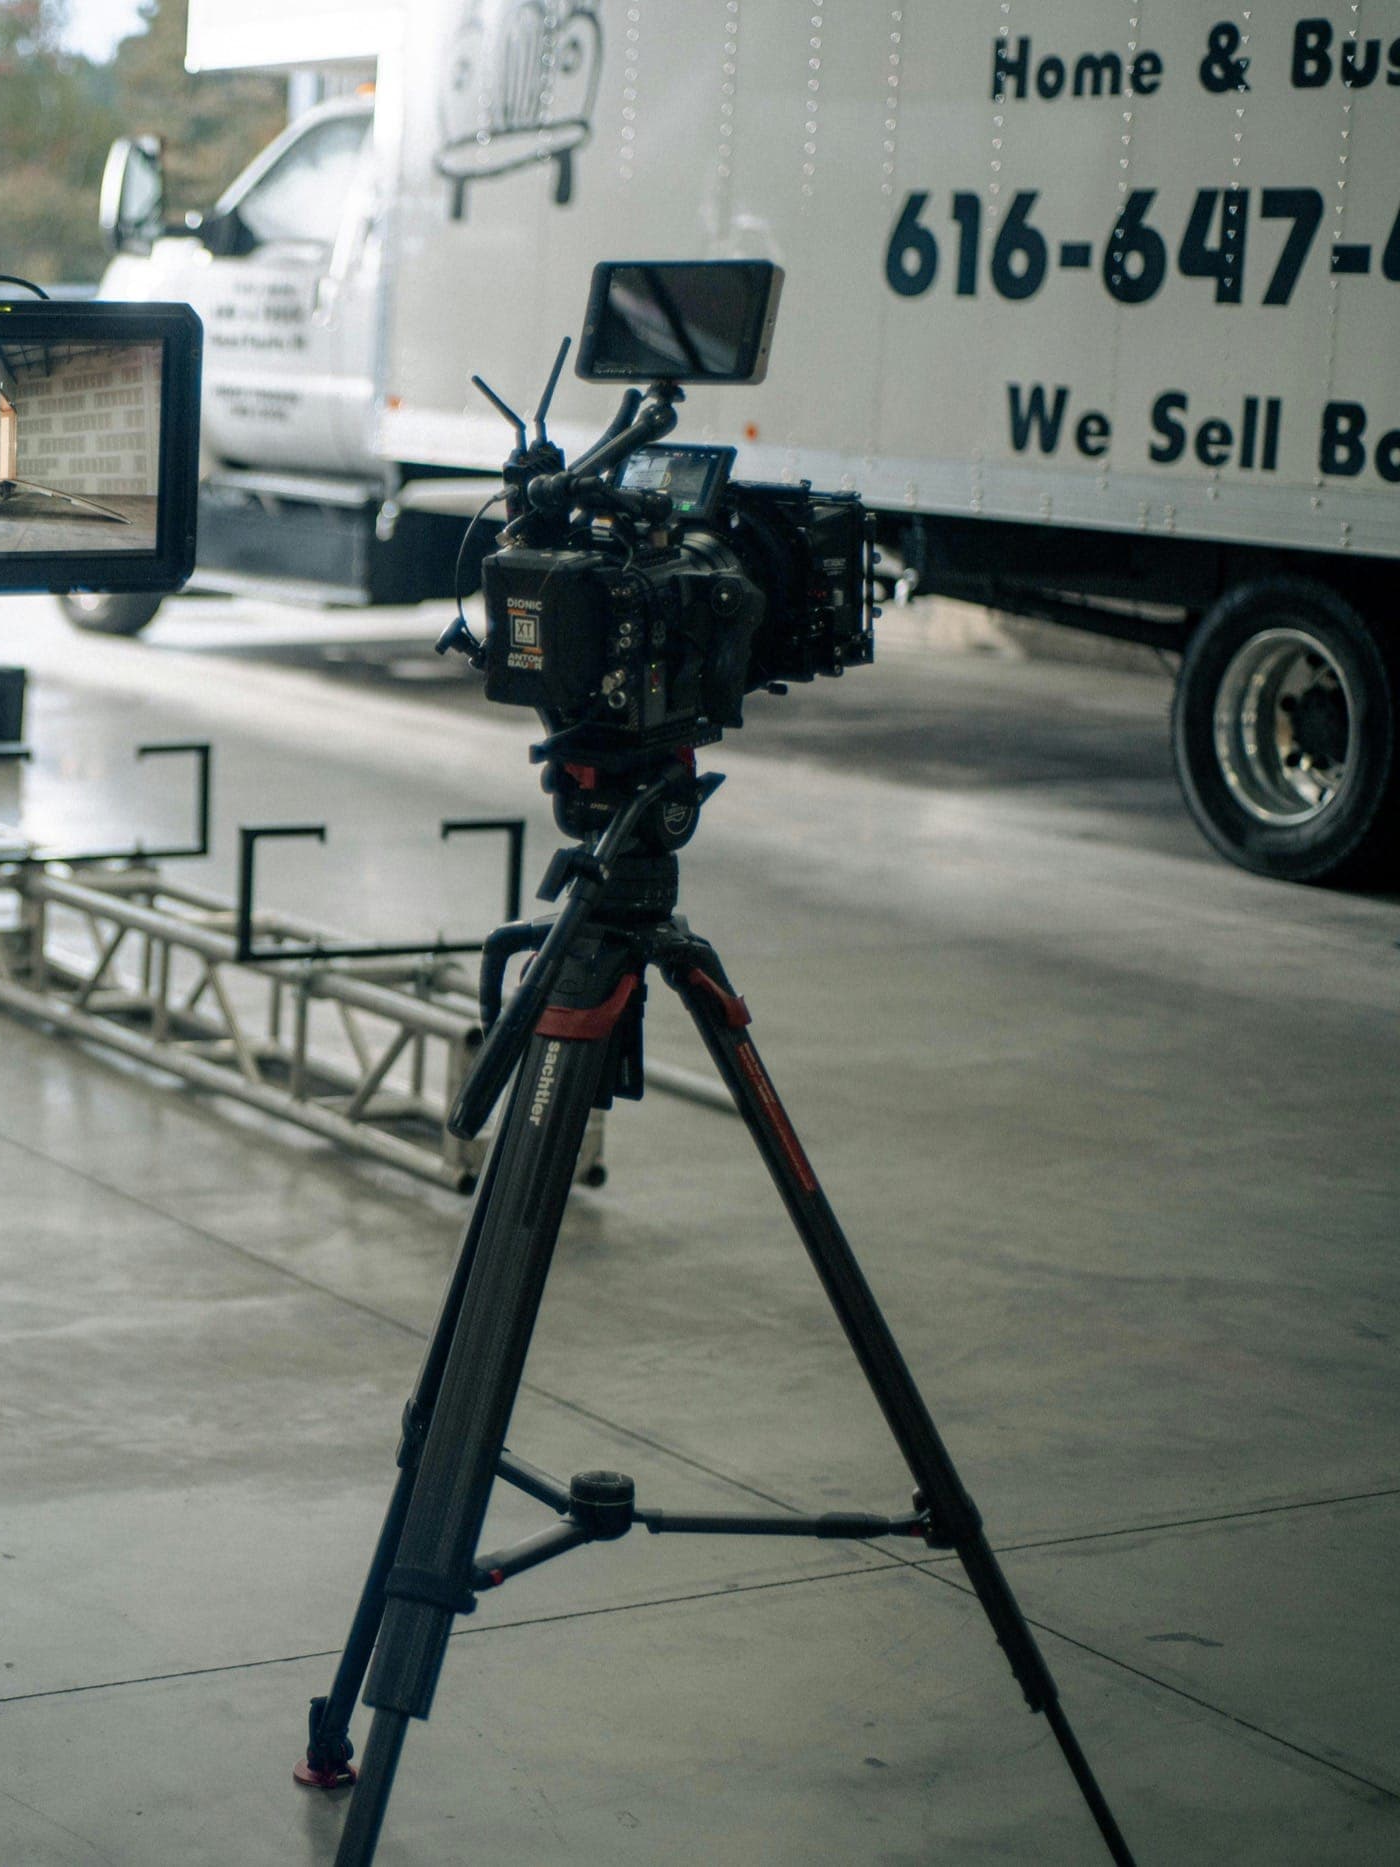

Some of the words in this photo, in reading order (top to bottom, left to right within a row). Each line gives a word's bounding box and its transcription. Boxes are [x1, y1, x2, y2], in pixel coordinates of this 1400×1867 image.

[992, 35, 1163, 101] Home
[1199, 20, 1251, 93] &
[1008, 383, 1111, 457] We
[1148, 390, 1282, 471] Sell
[517, 623, 532, 636] XT
[529, 1041, 561, 1126] sachtler
